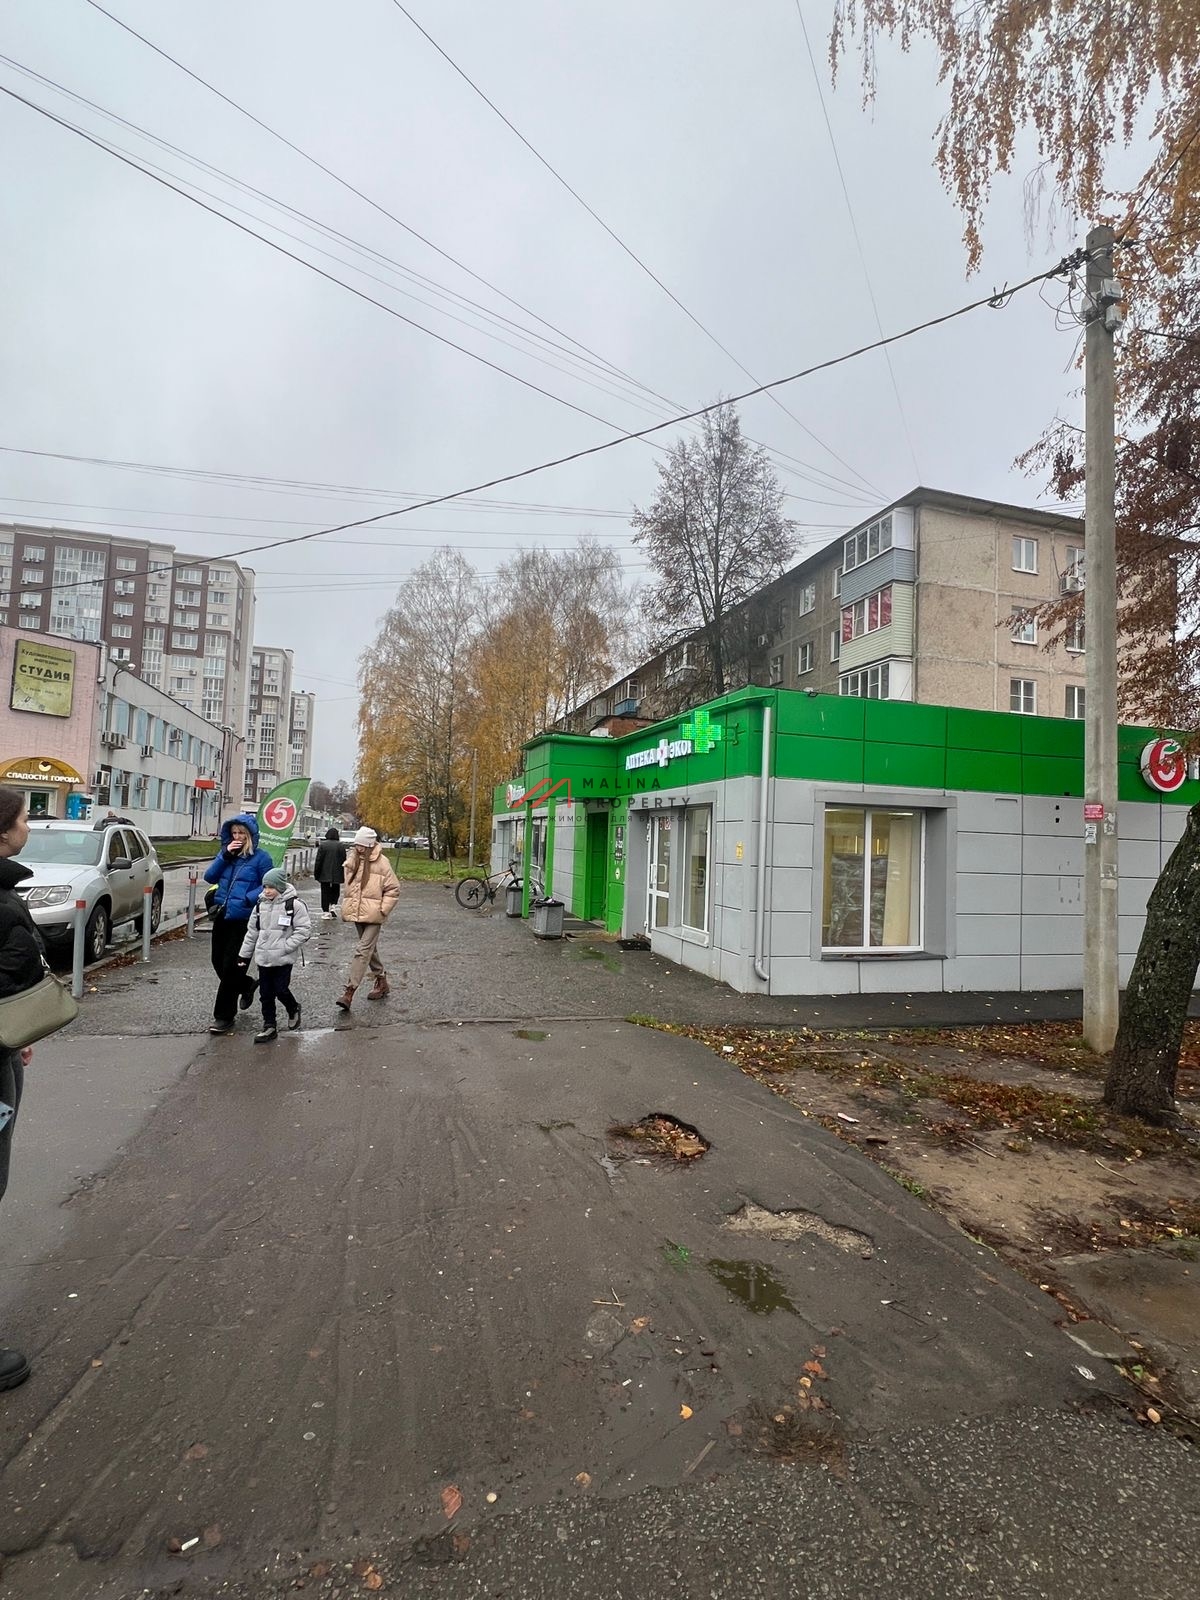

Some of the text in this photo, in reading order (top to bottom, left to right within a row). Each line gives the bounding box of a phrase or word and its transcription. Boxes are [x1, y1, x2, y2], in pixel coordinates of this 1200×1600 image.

[19, 664, 70, 681] СТУДИЯ
[625, 748, 657, 770] АПТЕКА
[6, 772, 80, 783] СЛАДОСТИ ГОРОДА
[271, 801, 293, 824] 5
